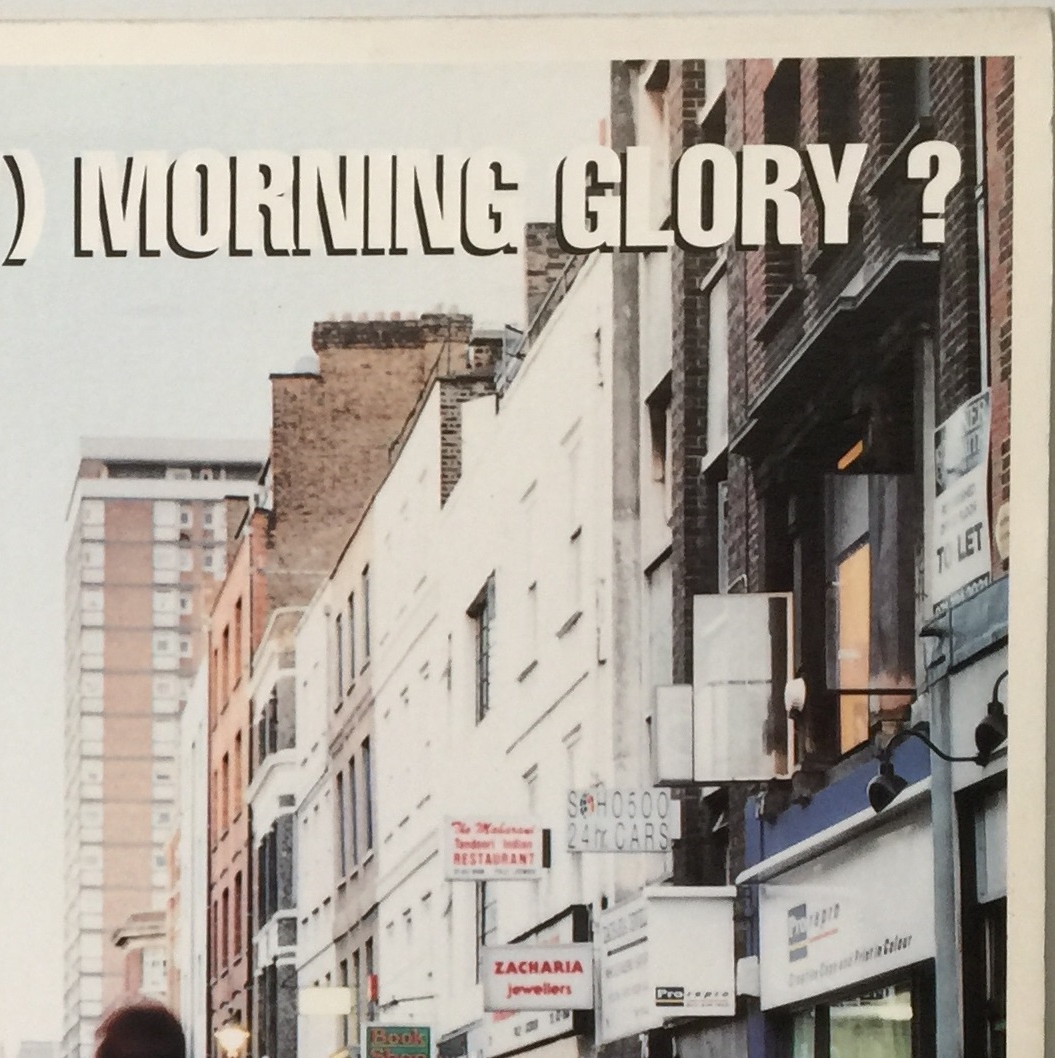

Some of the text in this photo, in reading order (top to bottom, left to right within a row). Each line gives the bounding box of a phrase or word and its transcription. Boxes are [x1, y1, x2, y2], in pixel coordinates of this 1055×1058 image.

[74, 145, 525, 257] MORNING
[556, 142, 869, 255] GLORY
[903, 141, 962, 247] ?
[957, 521, 983, 562] LET
[614, 821, 669, 851] CARS
[453, 852, 535, 866] RESTAURANT
[883, 934, 913, 956] Colour
[494, 960, 584, 975] ZACHARIA
[506, 983, 572, 999] jewellers
[657, 988, 684, 999] Pro
[370, 1027, 425, 1047] Book
